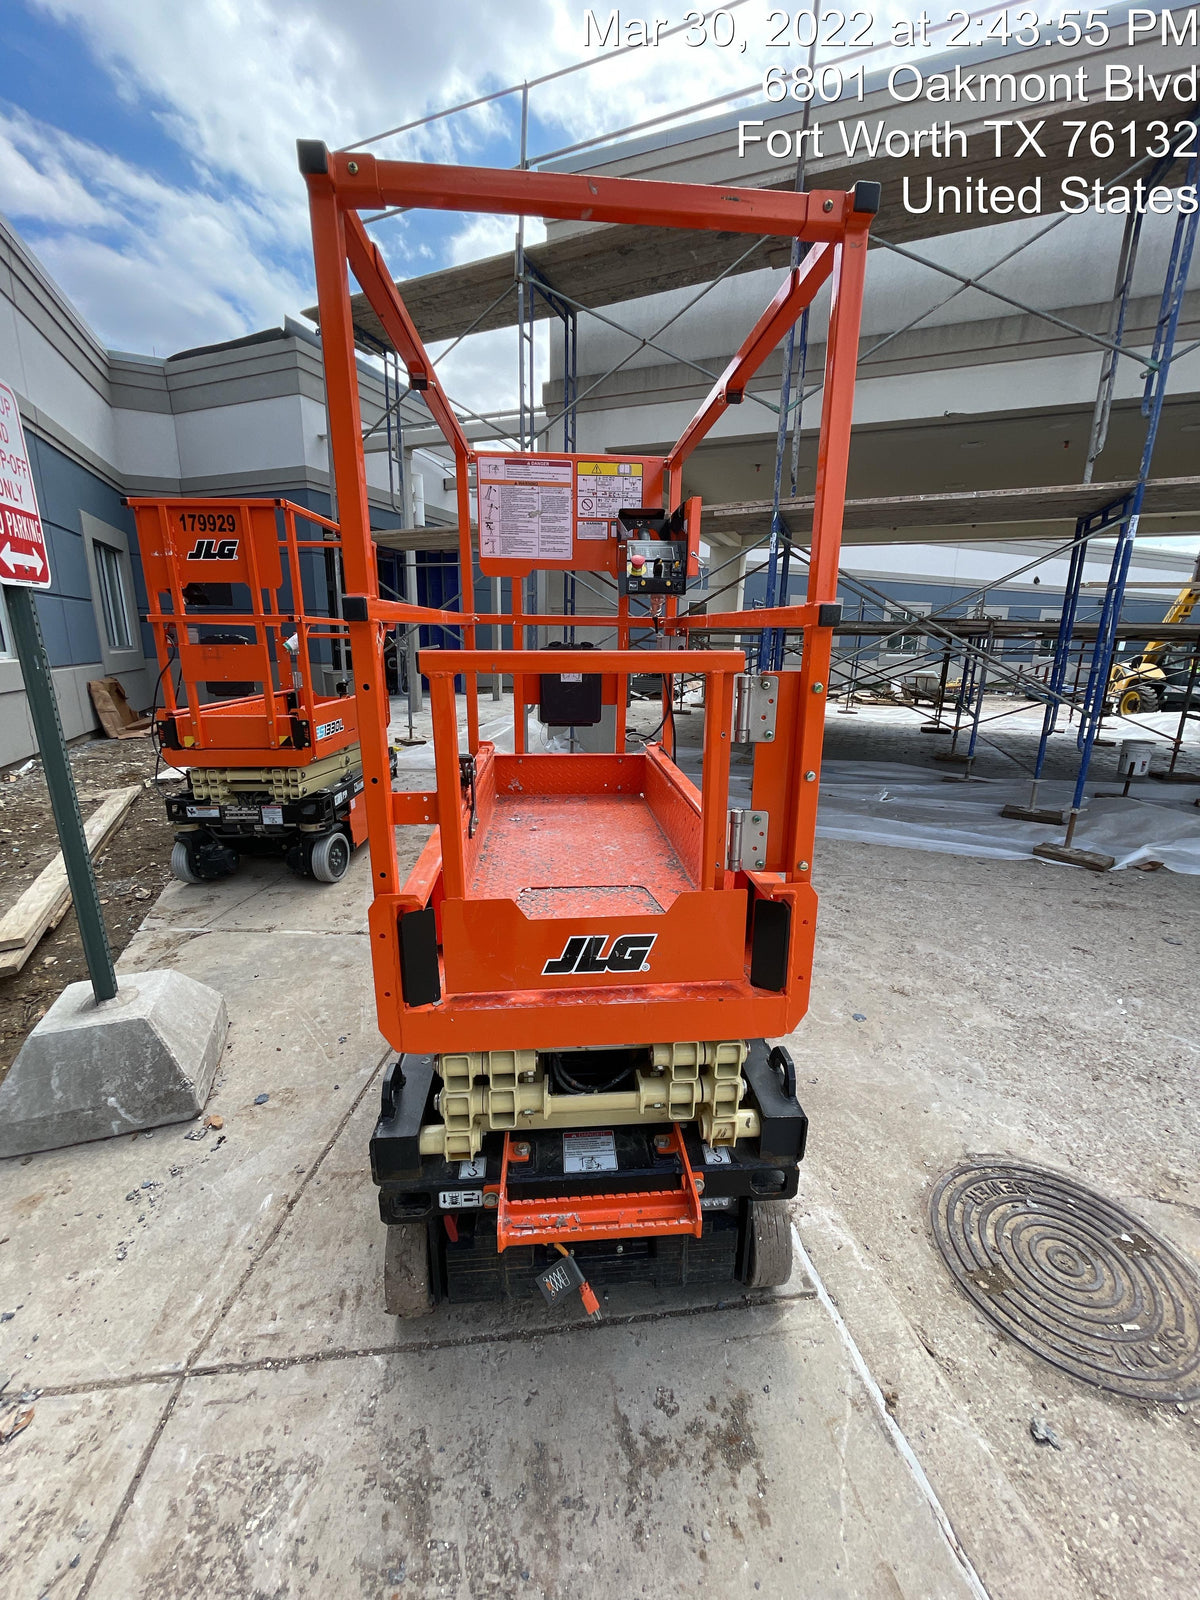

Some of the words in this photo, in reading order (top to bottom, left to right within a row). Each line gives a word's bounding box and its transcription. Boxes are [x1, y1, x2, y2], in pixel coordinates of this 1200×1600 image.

[5, 510, 42, 544] PARKING
[179, 513, 236, 533] 179929
[187, 539, 239, 560] JLG
[541, 933, 658, 976] JLG
[965, 1180, 1030, 1206] SEWER
